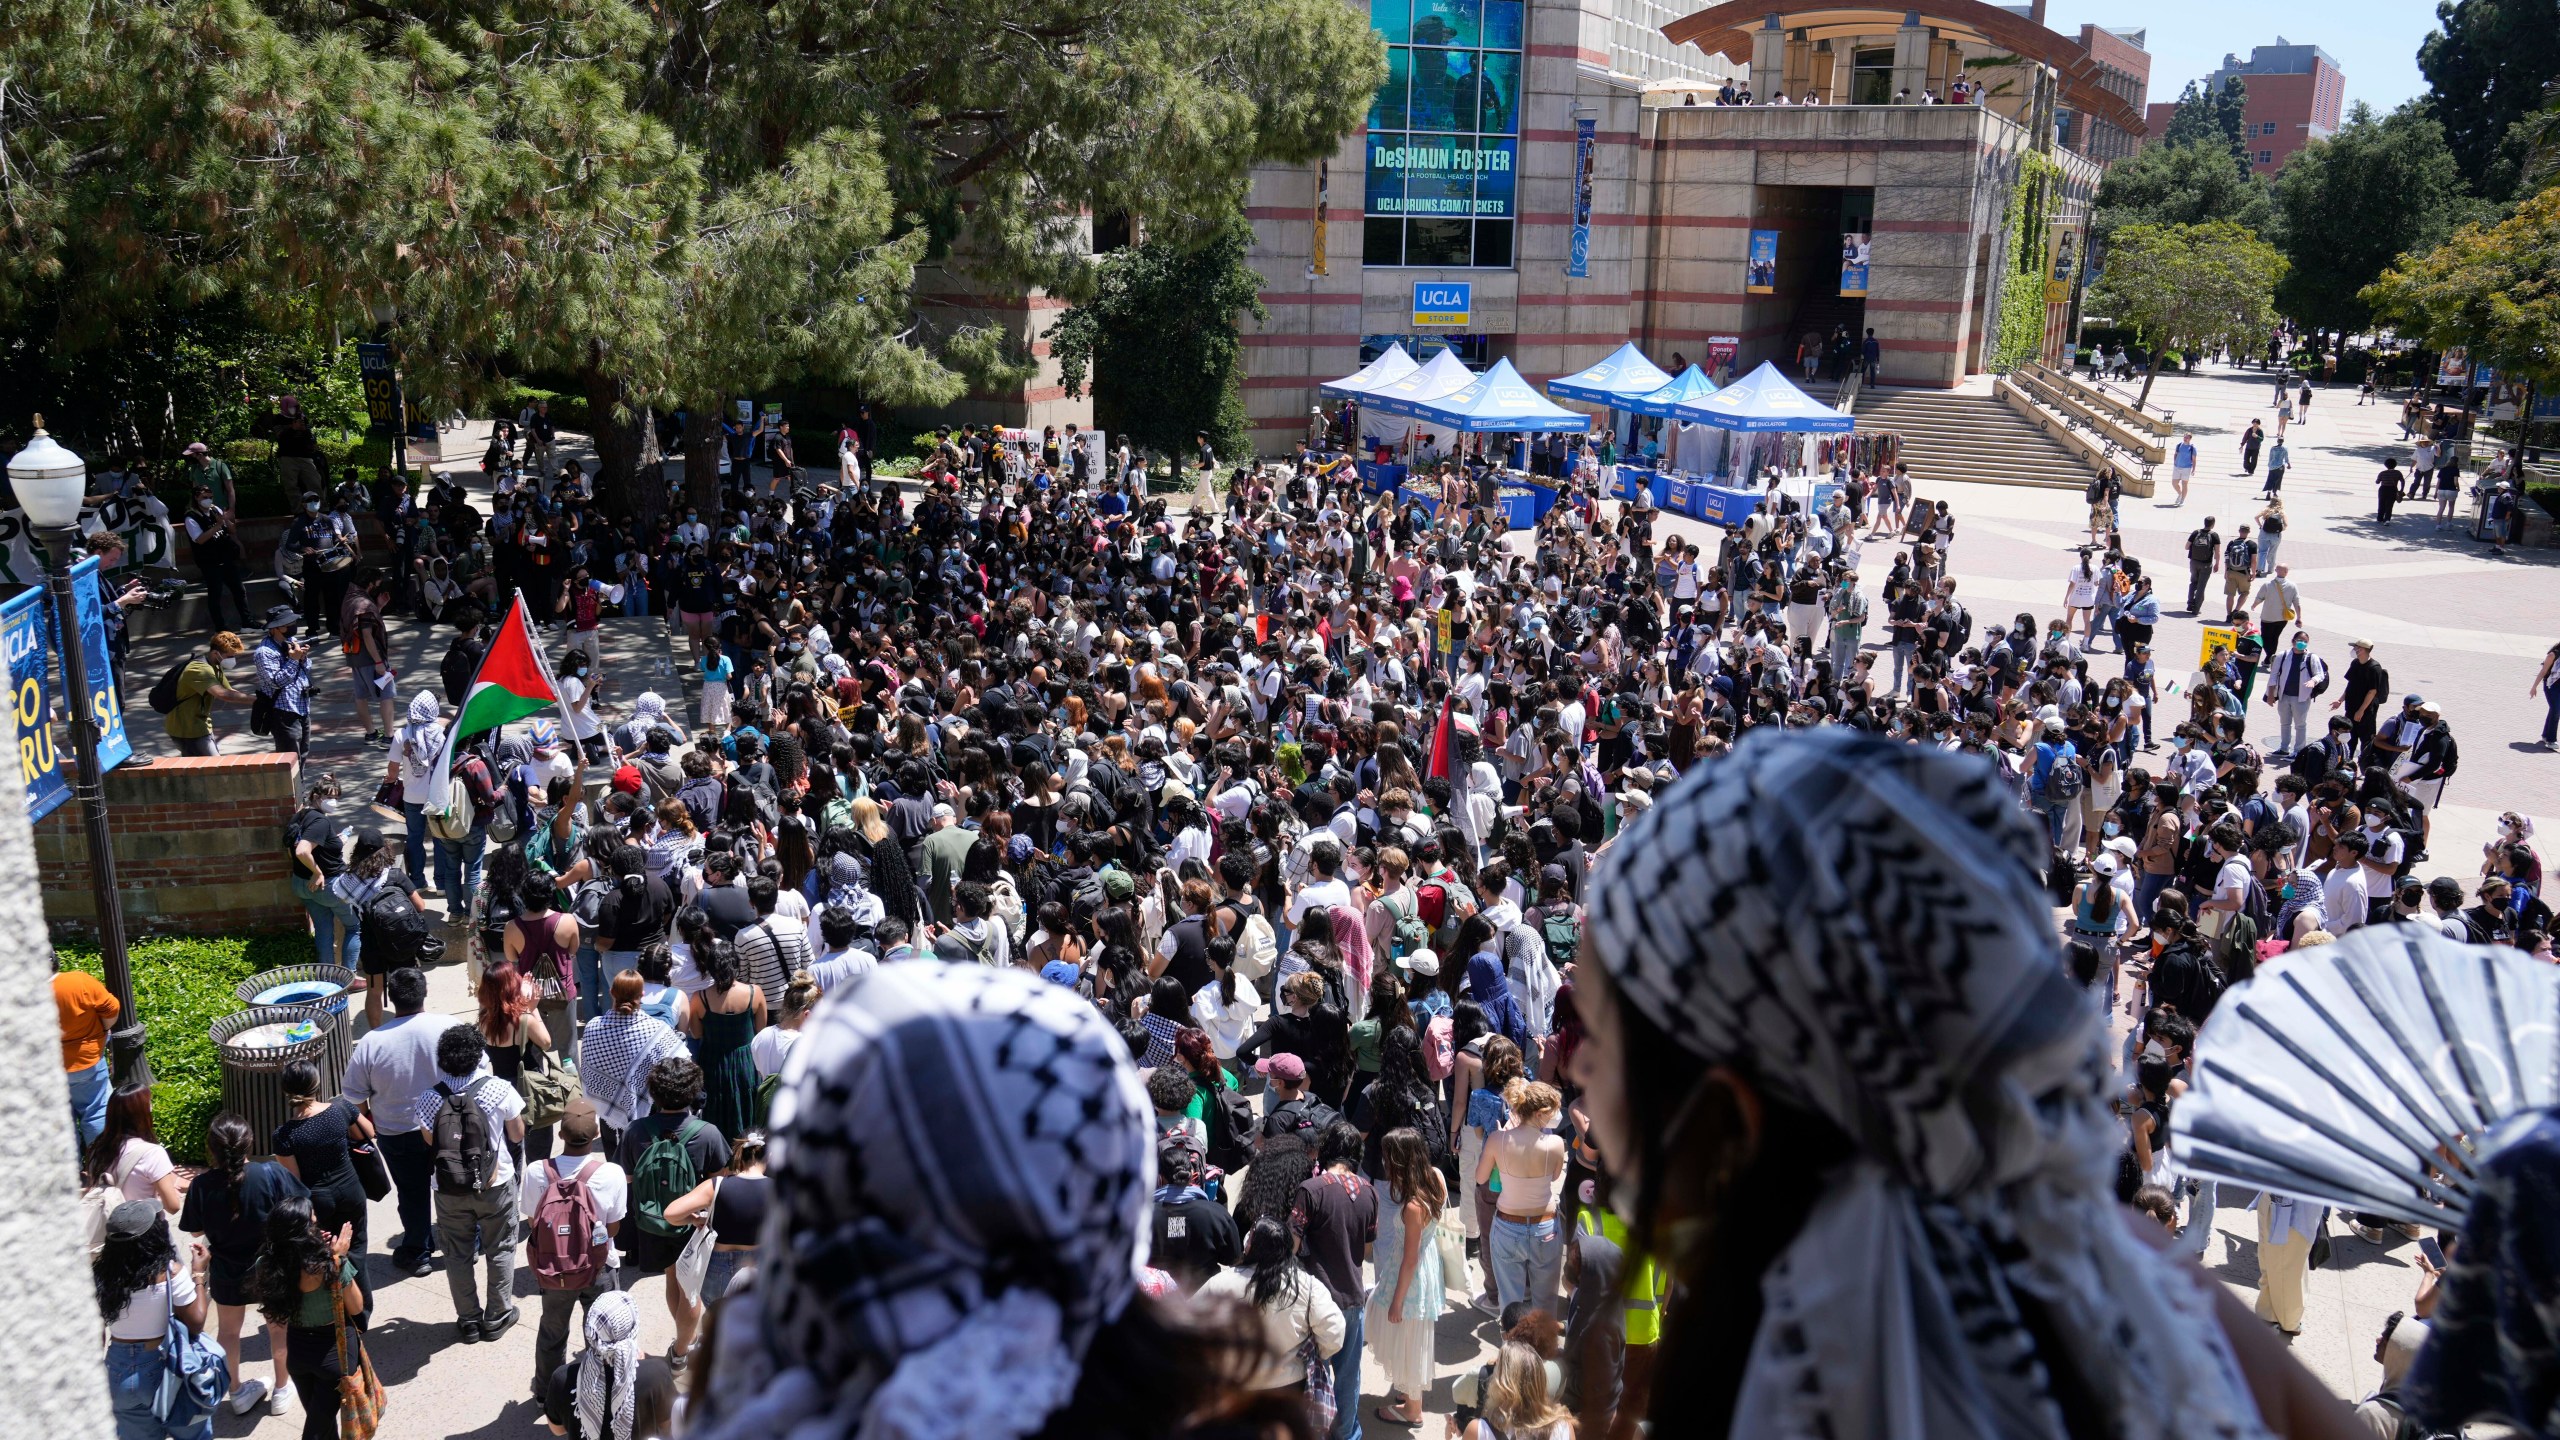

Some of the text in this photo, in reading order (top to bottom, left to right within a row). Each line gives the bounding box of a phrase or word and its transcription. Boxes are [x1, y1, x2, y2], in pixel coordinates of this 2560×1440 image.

[1375, 146, 1510, 171] DeSHAUN FOSTER
[1421, 290, 1462, 306] UCLA
[362, 357, 387, 370] UCLA
[367, 379, 391, 400] GO
[1501, 390, 1528, 399] UCLA
[1769, 392, 1794, 400] UCLA
[1001, 432, 1029, 440] ANTI-
[1003, 441, 1040, 452] ZIOSM
[1673, 485, 1686, 495] UCLA
[1709, 498, 1722, 508] UCLA
[19, 721, 55, 786] RU
